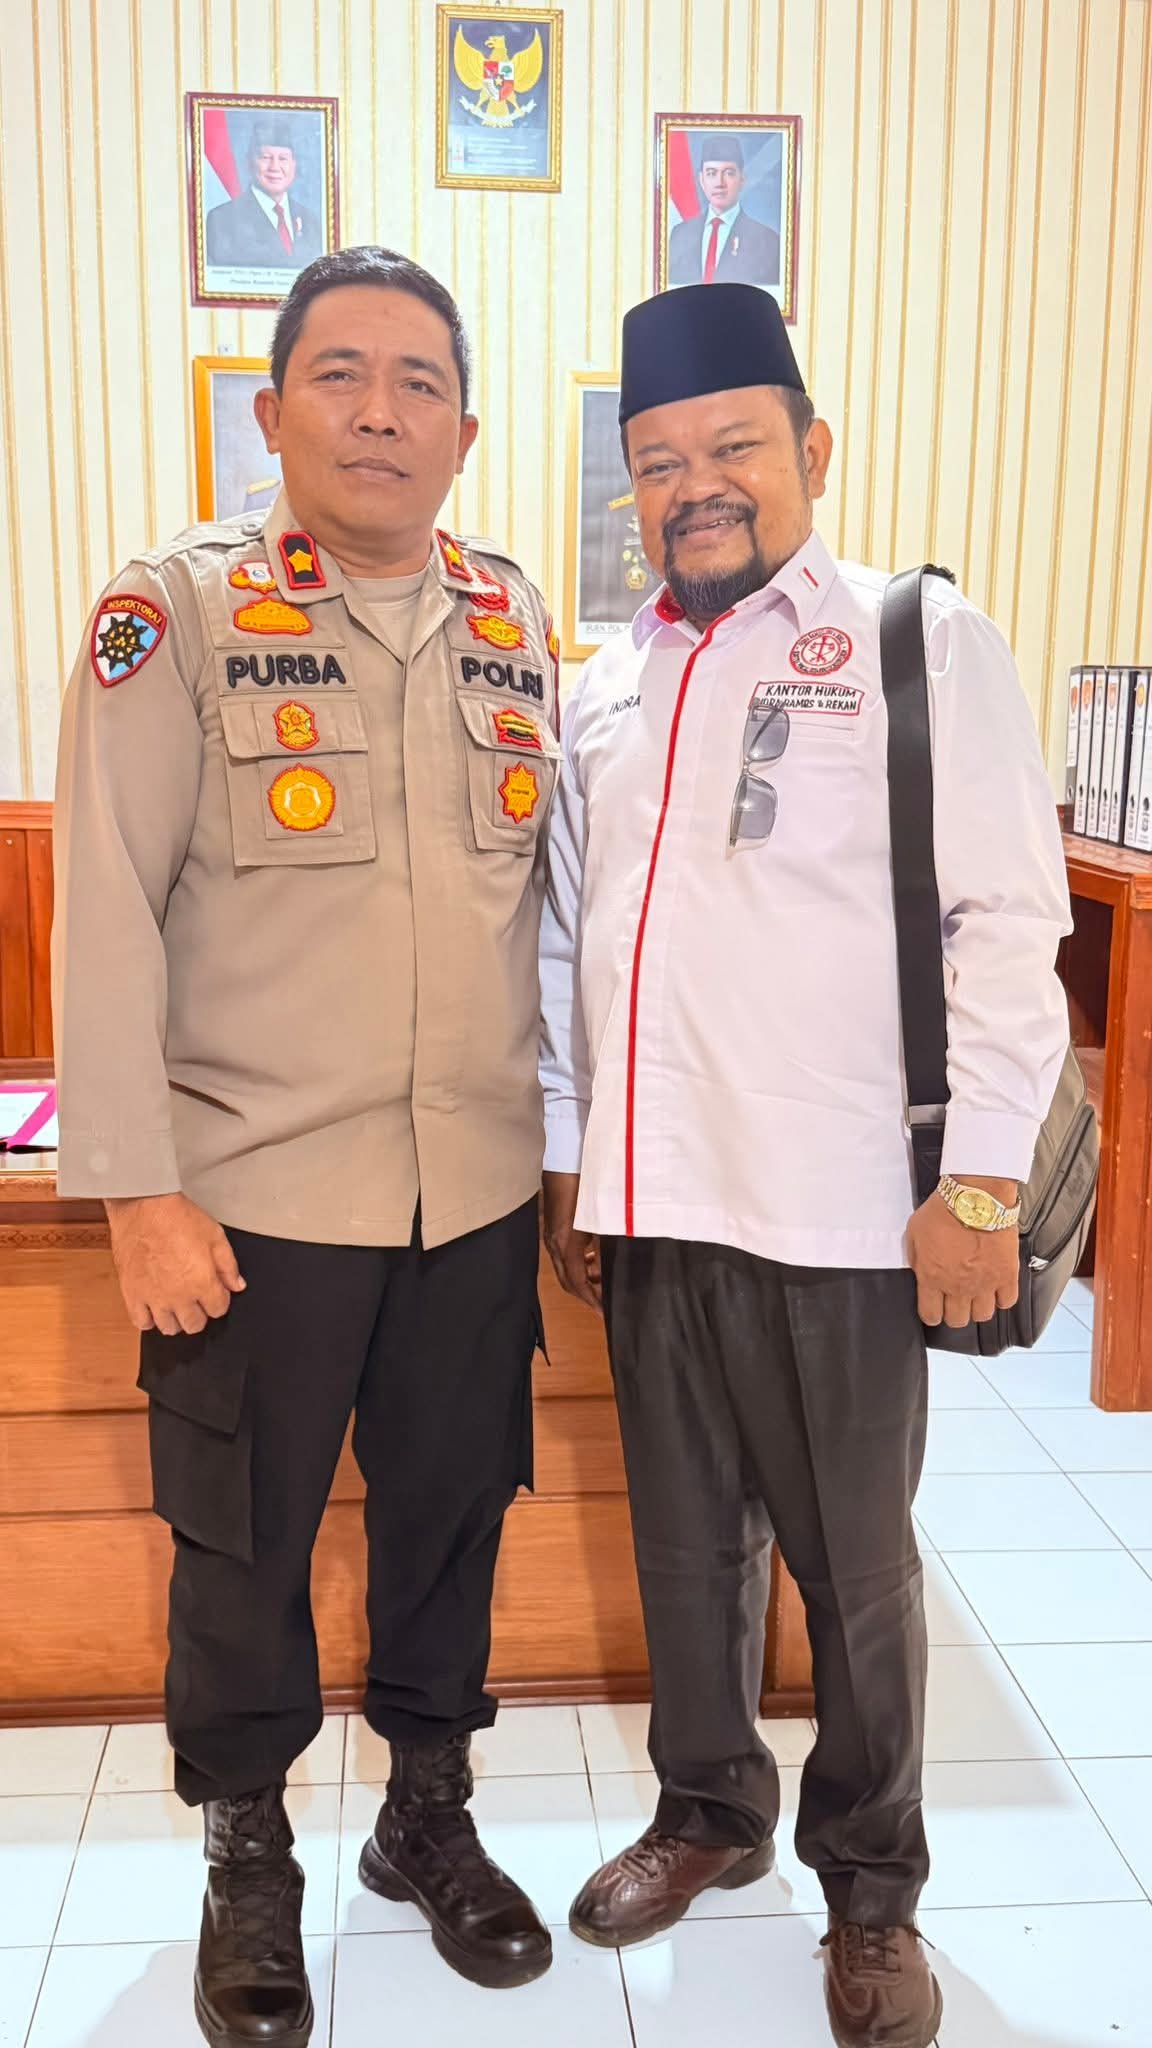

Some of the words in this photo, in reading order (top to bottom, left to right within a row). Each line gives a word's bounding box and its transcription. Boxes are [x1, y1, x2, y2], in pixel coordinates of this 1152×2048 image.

[226, 653, 347, 688] PURBA
[460, 656, 544, 701] POLRI
[765, 684, 812, 697] KANTOR
[814, 685, 857, 698] HUKUM
[608, 694, 641, 716] INDRA
[825, 699, 857, 711] REKAN
